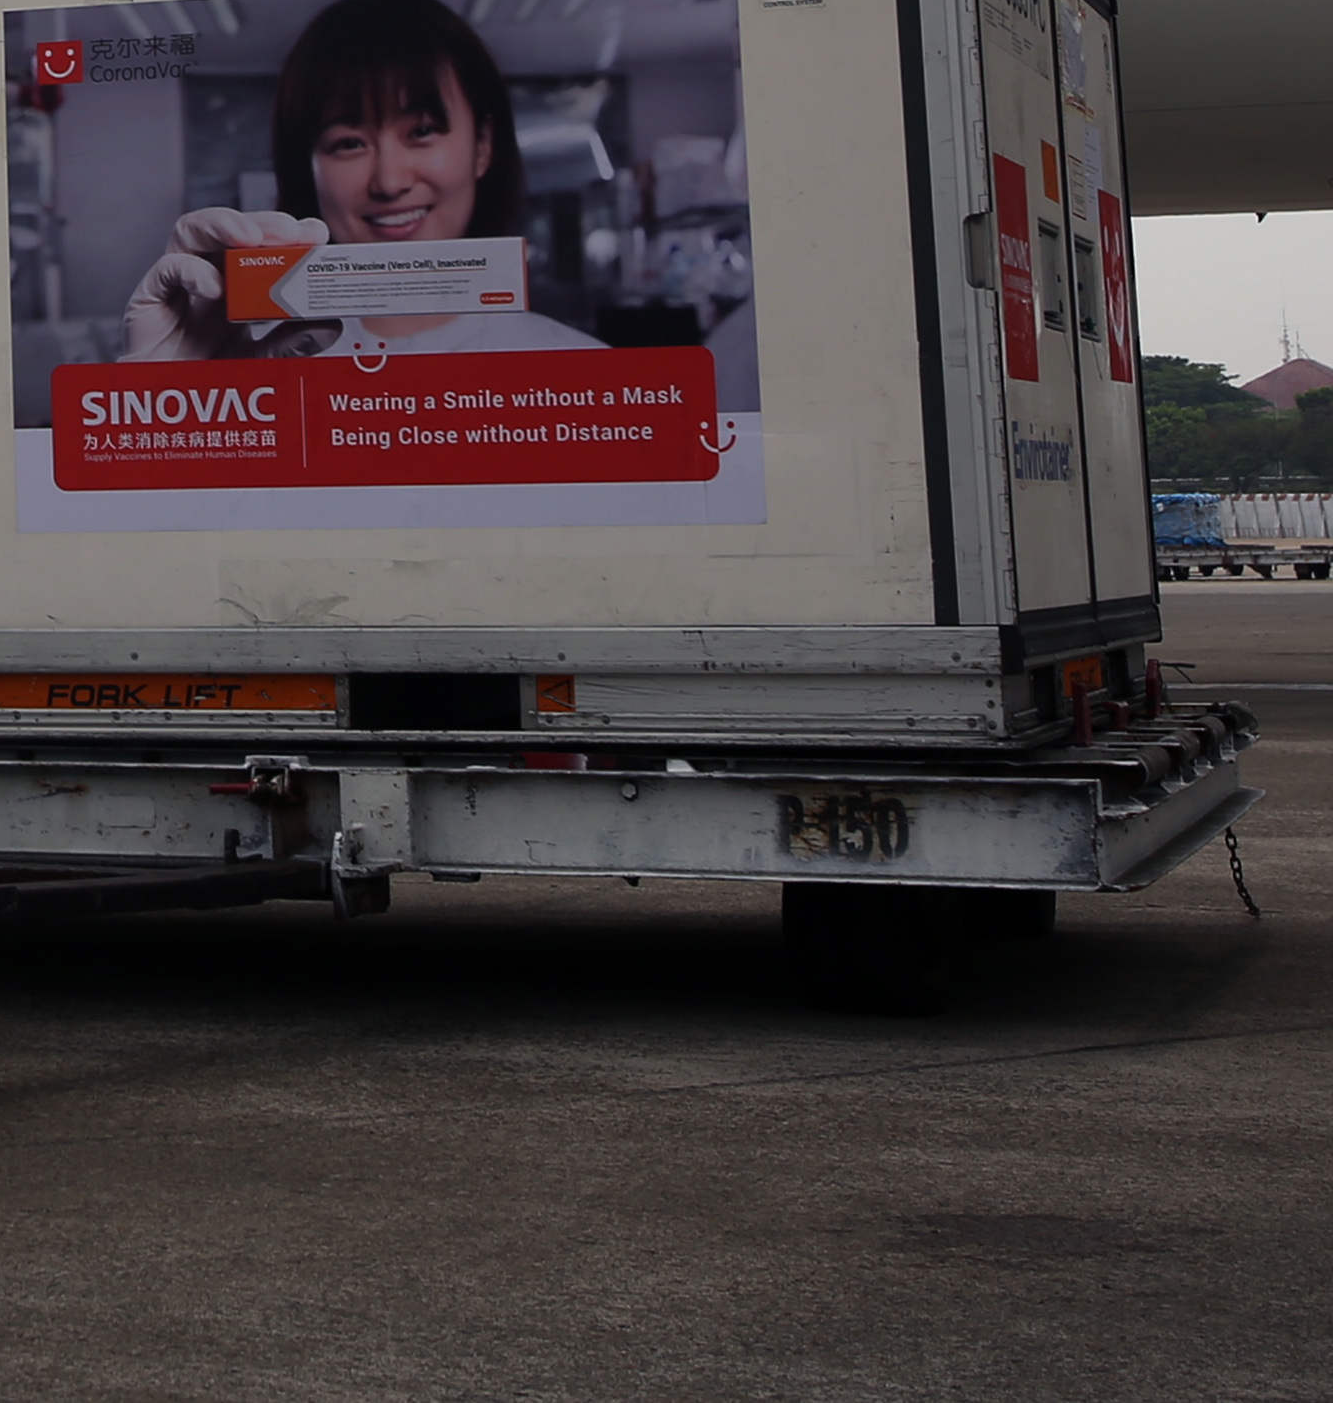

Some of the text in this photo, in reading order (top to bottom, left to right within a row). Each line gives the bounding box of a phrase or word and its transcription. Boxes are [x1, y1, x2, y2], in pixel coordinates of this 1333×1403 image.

[90, 33, 195, 61] 克尔来福
[90, 61, 192, 83] CoronaVac
[239, 256, 285, 267] SINOVAC
[307, 262, 350, 273] COVID-19
[351, 261, 386, 271] Vaccine
[388, 260, 410, 271] (Vero
[437, 257, 487, 268] Inactivated
[81, 386, 277, 427] SINOVAC
[328, 385, 683, 415] Wearing a Smile without a Mask
[83, 429, 277, 451] 为人类消除疾病提供疫苗
[331, 421, 654, 449] Being Close without Distance
[84, 449, 278, 463] Supply Vaccines to Eliminate Human Diseases
[46, 684, 242, 707] FORK LIFT
